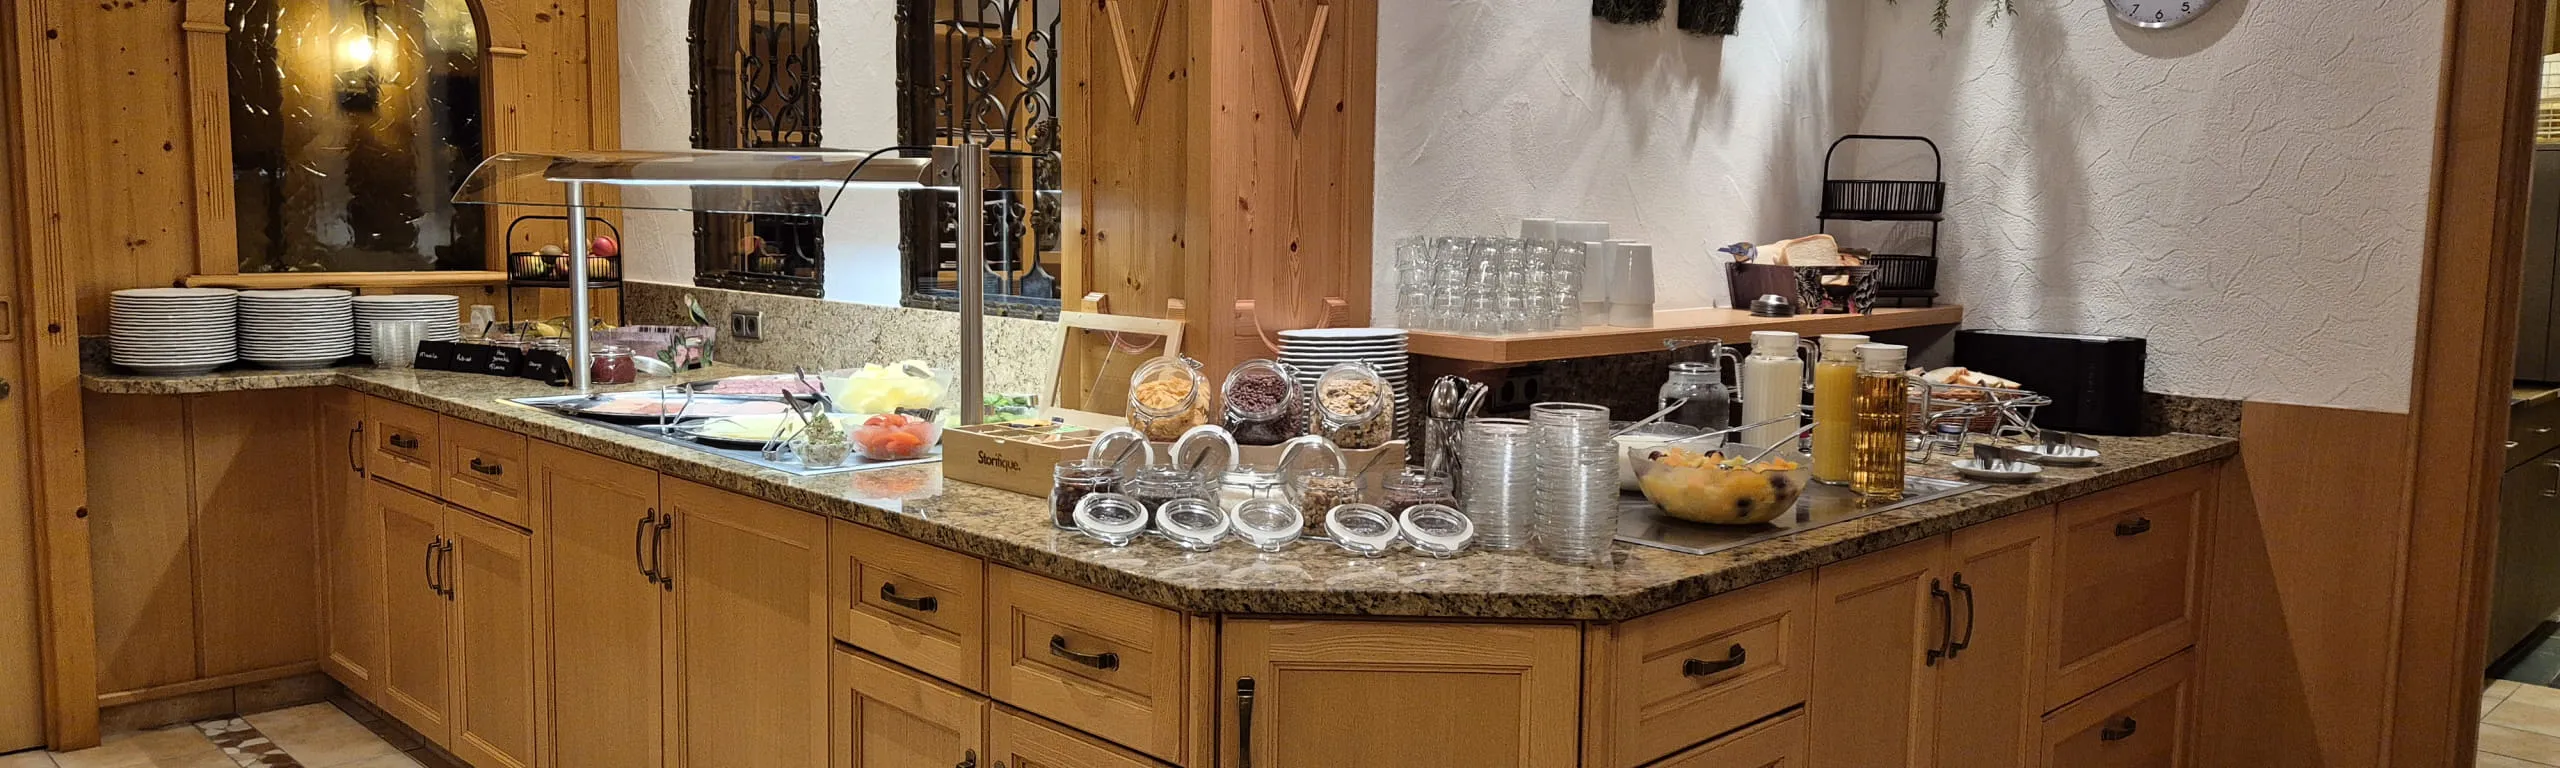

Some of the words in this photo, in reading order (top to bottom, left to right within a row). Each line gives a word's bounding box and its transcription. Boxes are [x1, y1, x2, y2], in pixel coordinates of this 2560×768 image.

[2132, 4, 2140, 14] 7
[2181, 1, 2190, 12] 5
[2155, 9, 2164, 19] 6
[977, 450, 1021, 472] Storifique.
